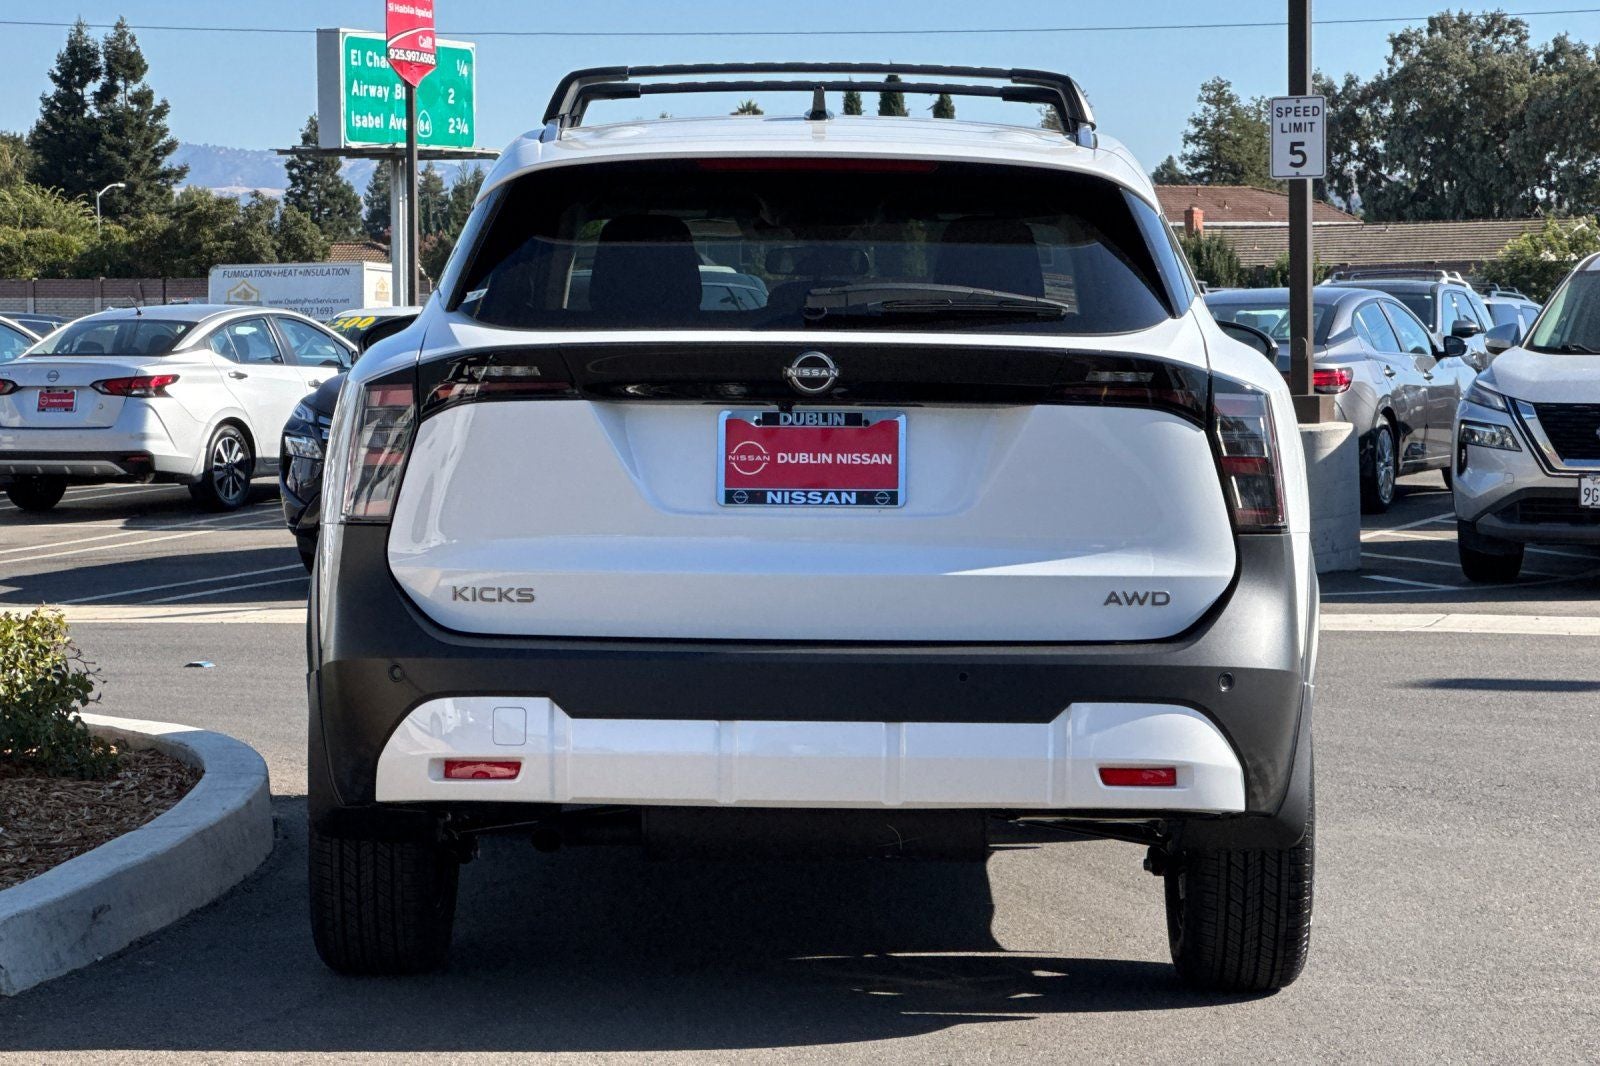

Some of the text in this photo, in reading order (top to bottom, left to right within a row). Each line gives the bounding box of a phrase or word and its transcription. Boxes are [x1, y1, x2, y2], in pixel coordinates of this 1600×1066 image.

[350, 49, 362, 67] El
[366, 50, 390, 69] Cha
[351, 79, 390, 103] Airway
[447, 88, 455, 104] 2
[1275, 105, 1320, 118] SPEED
[351, 110, 384, 129] Isabel
[419, 120, 430, 133] 84
[1280, 121, 1316, 134] LIMIT
[1288, 141, 1307, 168] 5
[787, 368, 839, 377] NISSAN
[779, 412, 846, 426] DUBLIN
[728, 454, 770, 462] NISSAN
[777, 452, 893, 465] DUBLIN NISSAN
[766, 491, 857, 504] NISSAN
[451, 585, 535, 603] KICKS
[1103, 590, 1171, 606] AWD
